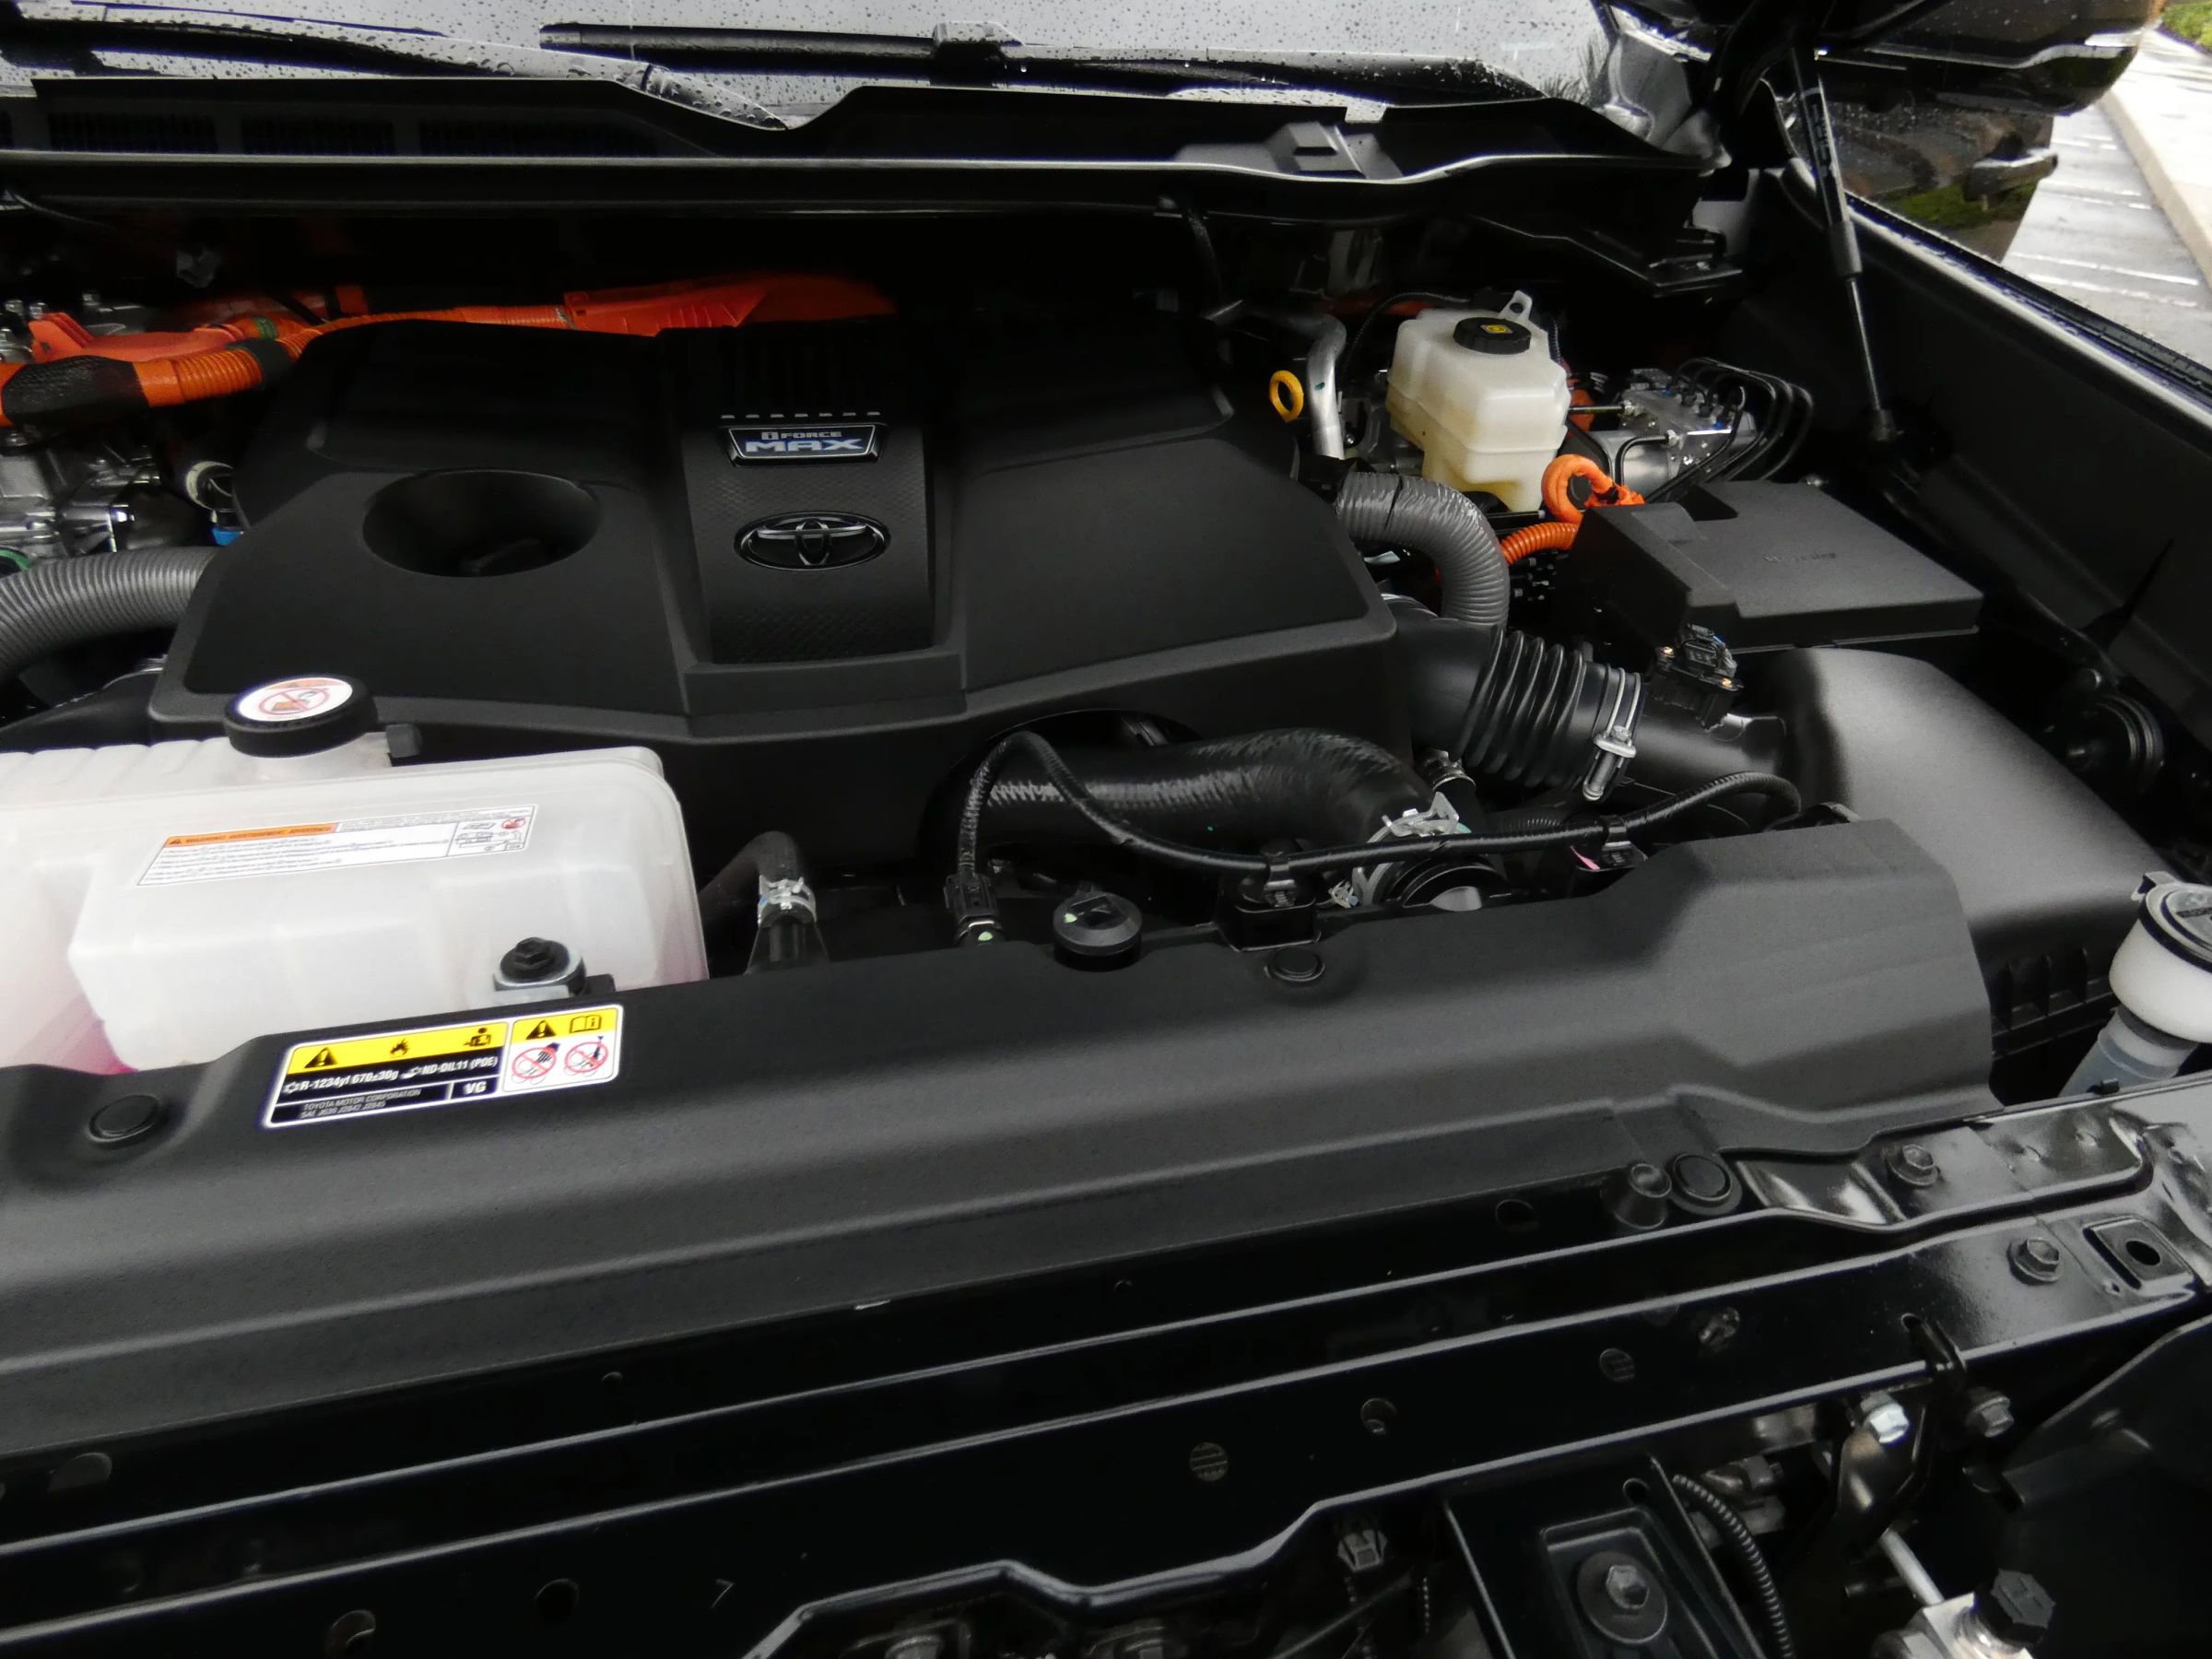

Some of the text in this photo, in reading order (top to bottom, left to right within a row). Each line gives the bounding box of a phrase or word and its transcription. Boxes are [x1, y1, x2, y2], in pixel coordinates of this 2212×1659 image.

[746, 439, 864, 452] MAX
[463, 1081, 487, 1095] VG
[303, 1088, 421, 1111] TOYOTA MOTOR CORPORATION
